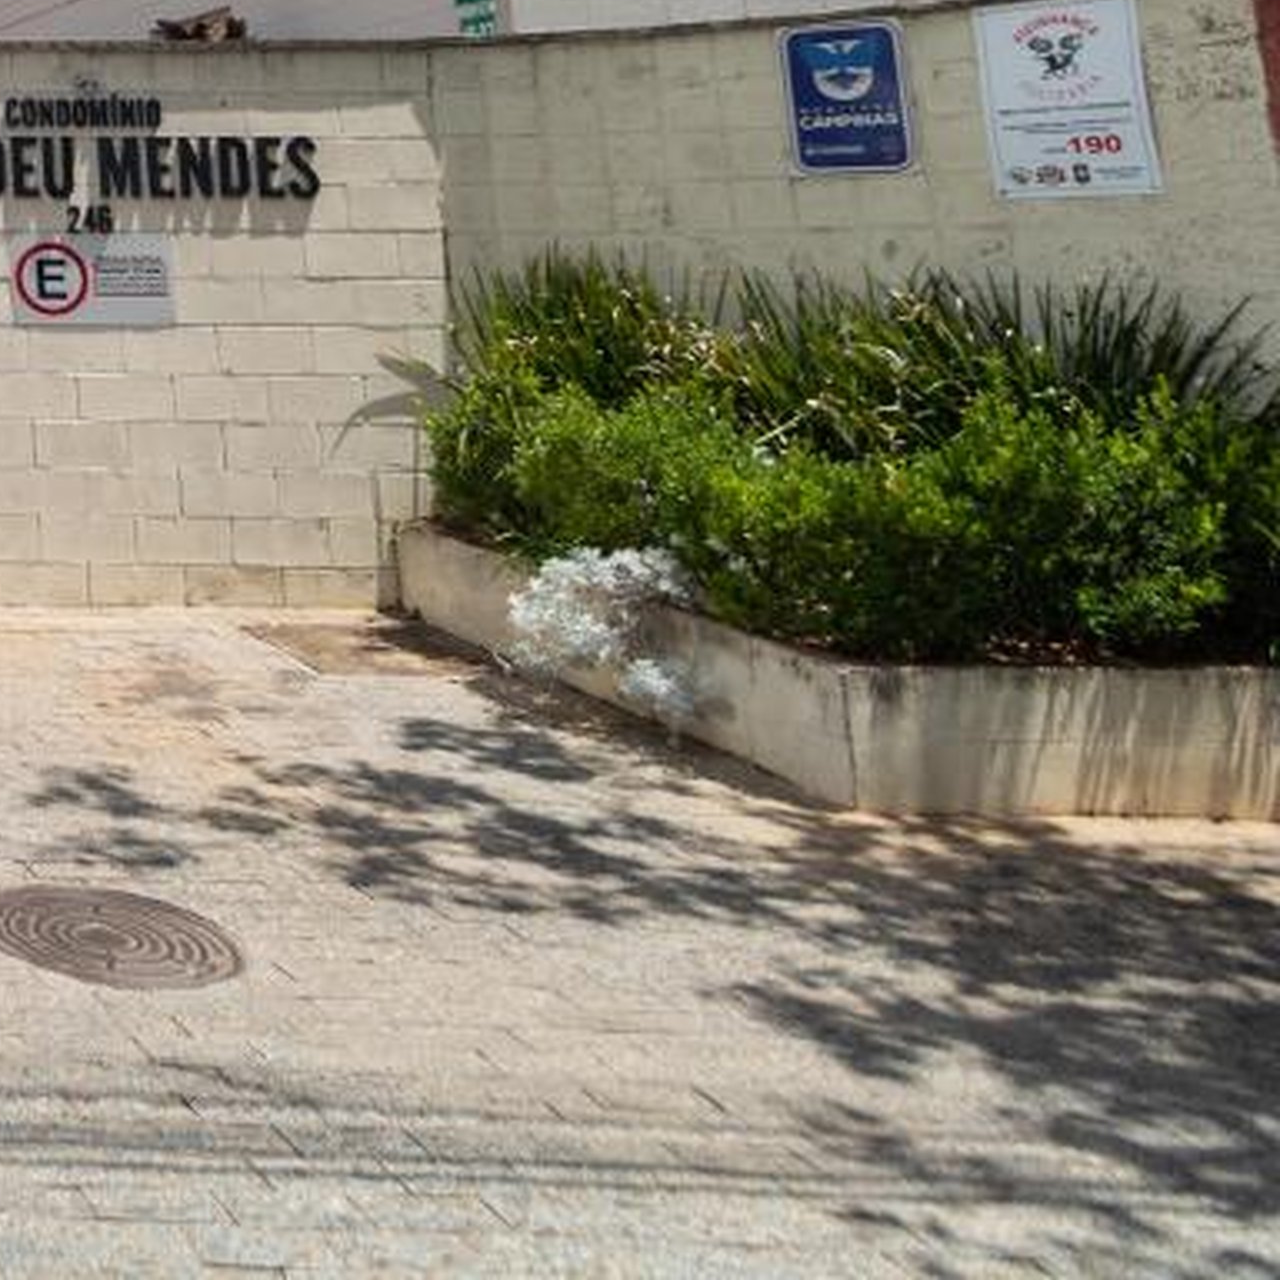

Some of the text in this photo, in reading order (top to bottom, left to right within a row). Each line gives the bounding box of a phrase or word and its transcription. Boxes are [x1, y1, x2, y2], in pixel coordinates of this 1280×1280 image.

[5, 92, 161, 128] CONDOMÍNIO
[1066, 133, 1122, 154] 190
[96, 136, 321, 199] MENDES
[66, 205, 113, 234] 246
[36, 259, 67, 300] E
